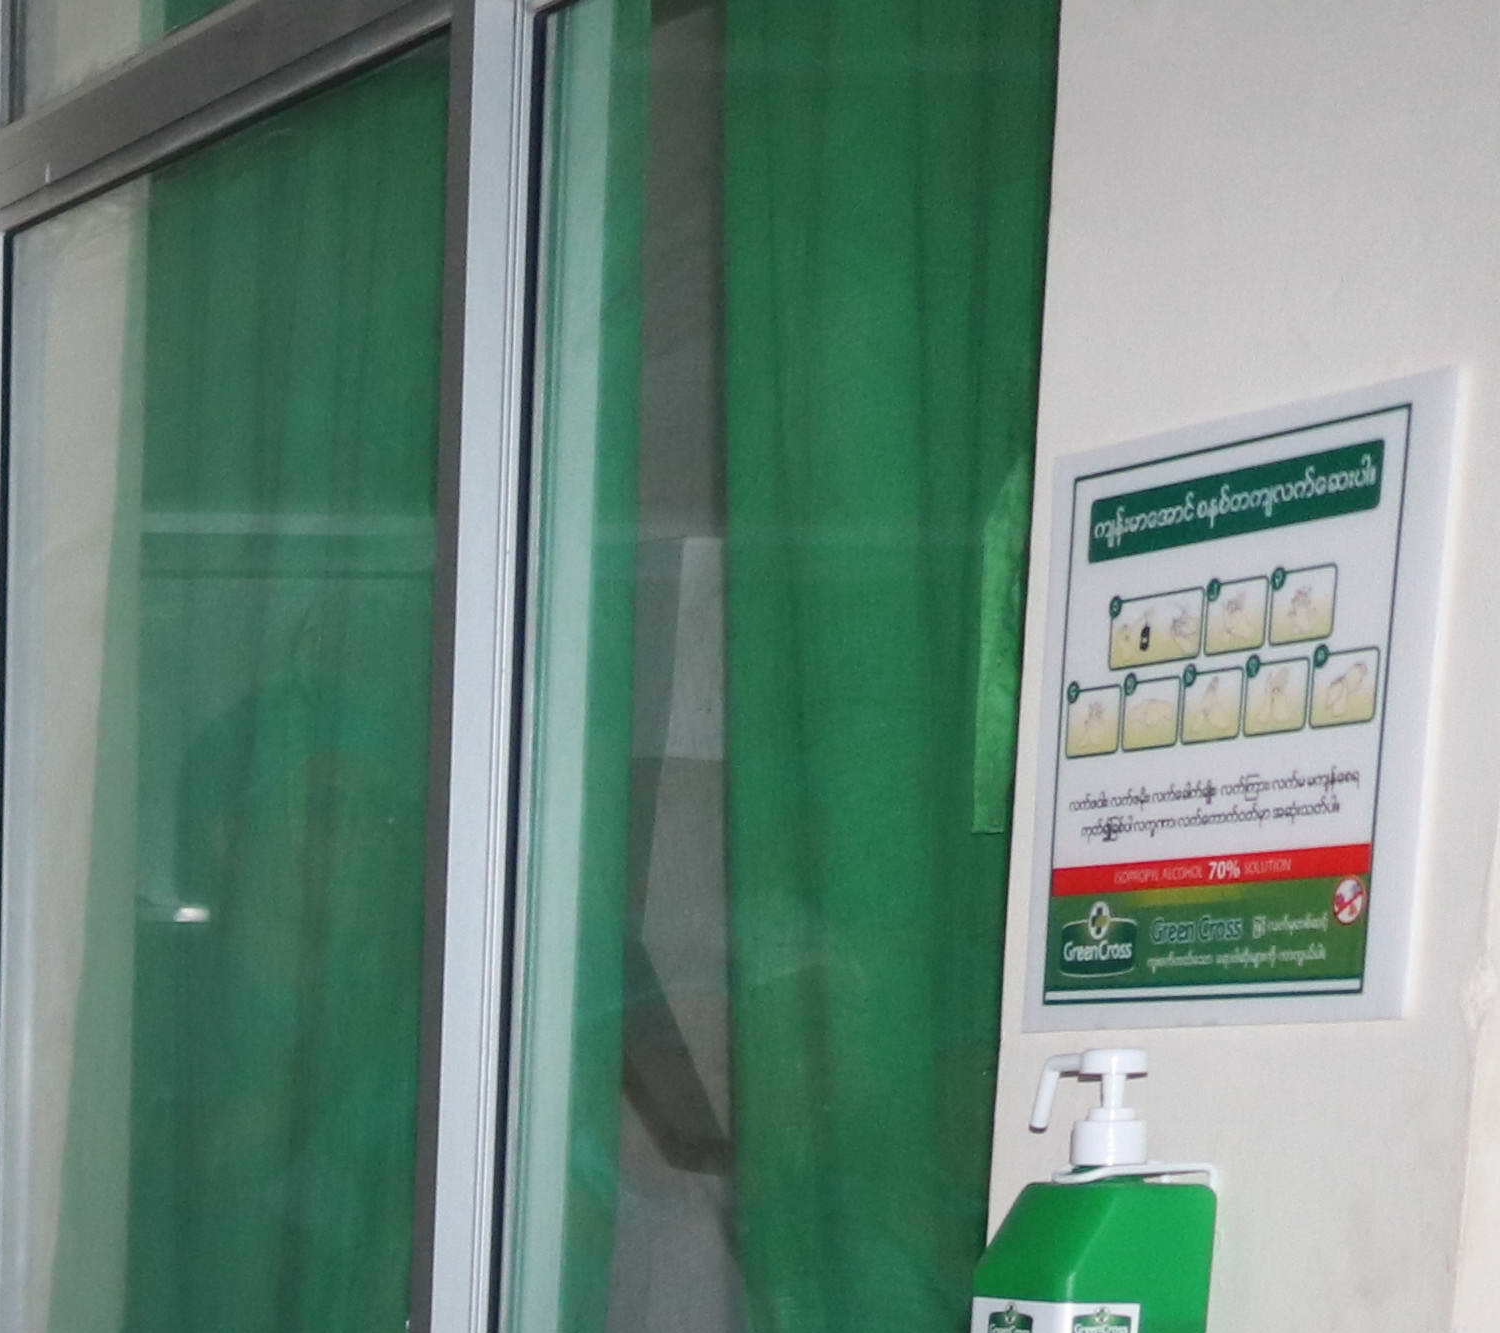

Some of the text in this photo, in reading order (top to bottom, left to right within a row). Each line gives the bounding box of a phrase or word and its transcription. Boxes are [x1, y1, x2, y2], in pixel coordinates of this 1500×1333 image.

[1208, 860, 1241, 880] 70%
[1151, 915, 1244, 944] Green Cross
[1063, 940, 1133, 962] GreenCross
